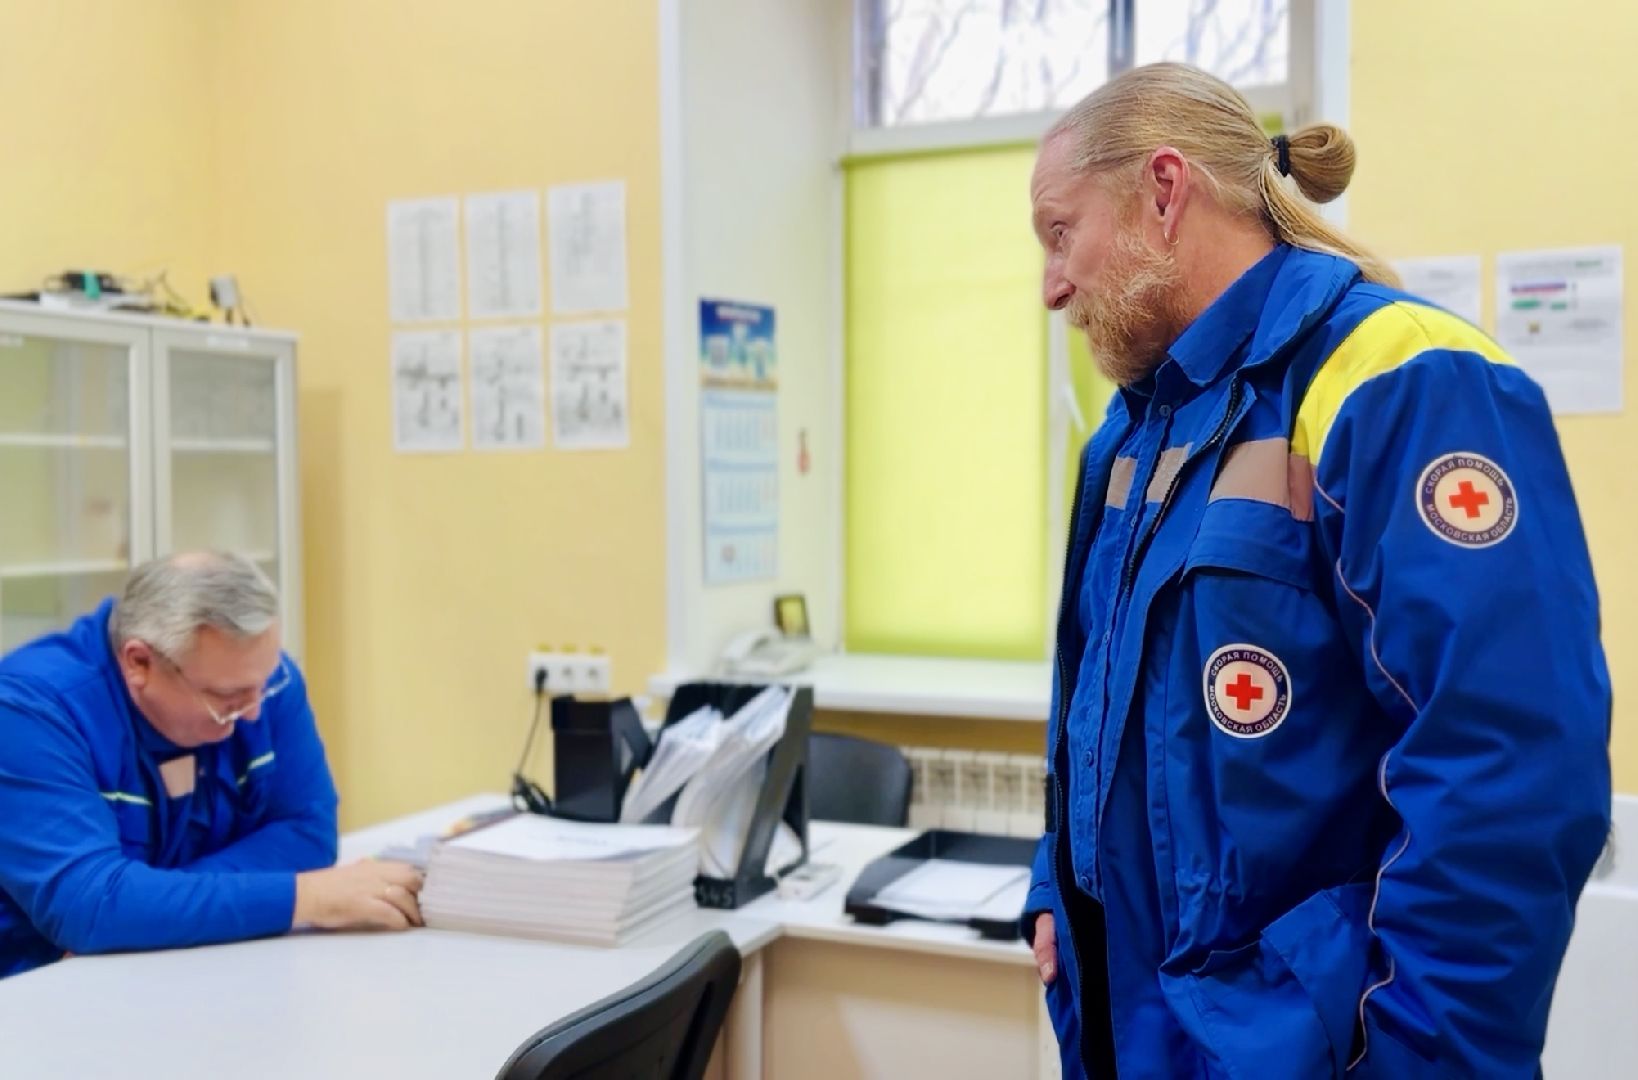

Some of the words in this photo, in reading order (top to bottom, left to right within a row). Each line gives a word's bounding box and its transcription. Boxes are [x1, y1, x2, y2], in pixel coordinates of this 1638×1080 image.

[1425, 460, 1455, 494] СКОРАЯ
[1457, 459, 1504, 486] ПОМОЩЬ
[1426, 504, 1490, 542] МОСКОВСКАЯ
[1490, 498, 1513, 537] ОБЛАСТЬ
[1211, 651, 1240, 676] СКОРАЯ
[1243, 651, 1283, 682] ПОМОЩЬ
[1209, 685, 1253, 733] МОСКОВСКАЯ
[1254, 694, 1286, 731] ОБЛАСТЬ
